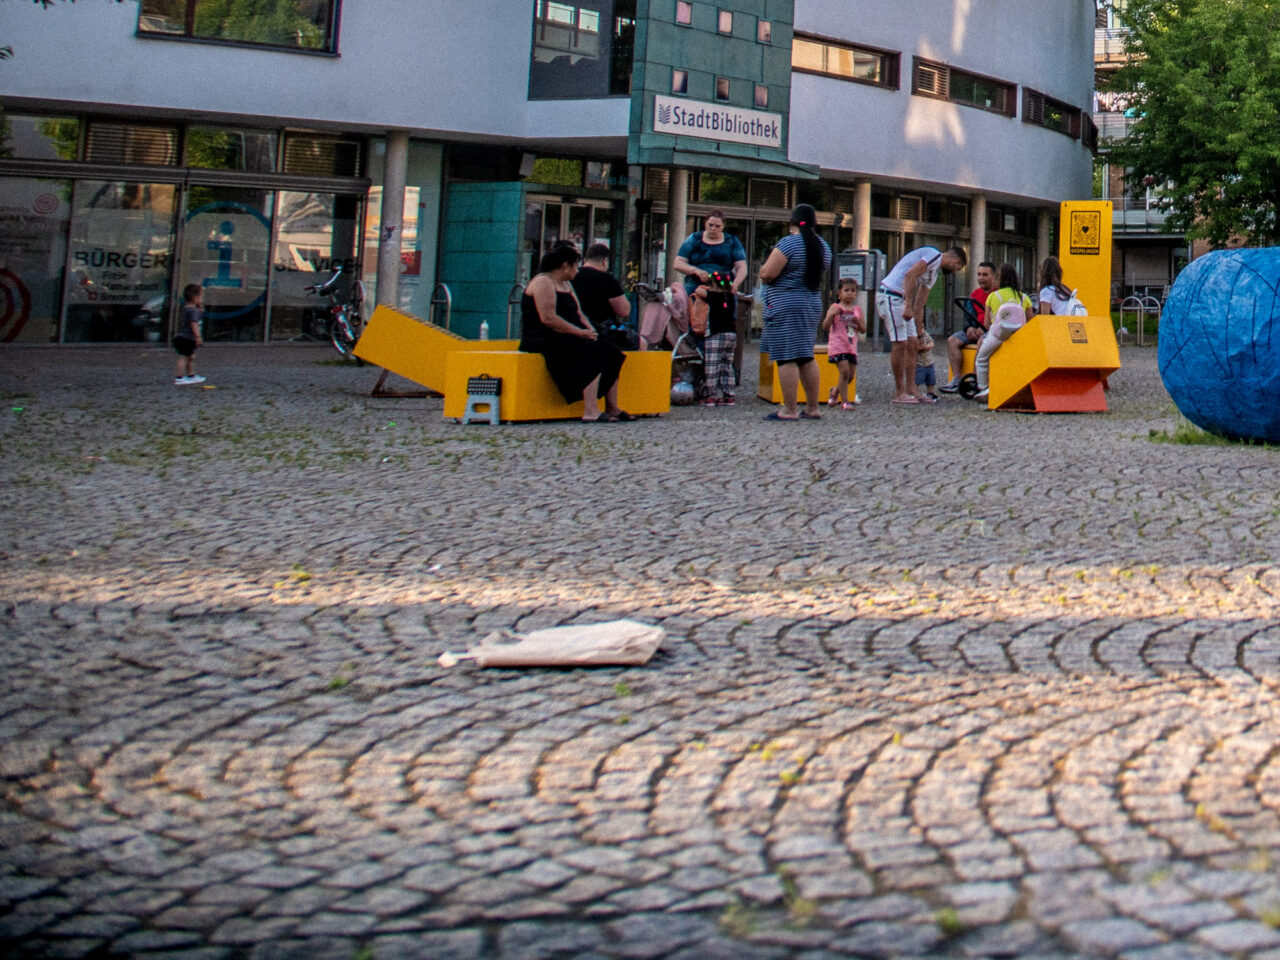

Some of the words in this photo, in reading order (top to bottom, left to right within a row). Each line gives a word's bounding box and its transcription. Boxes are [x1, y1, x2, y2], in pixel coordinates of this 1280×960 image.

[673, 106, 778, 139] StadtBibliothek
[74, 248, 168, 268] BÜRGER
[275, 258, 355, 274] SEVICE
